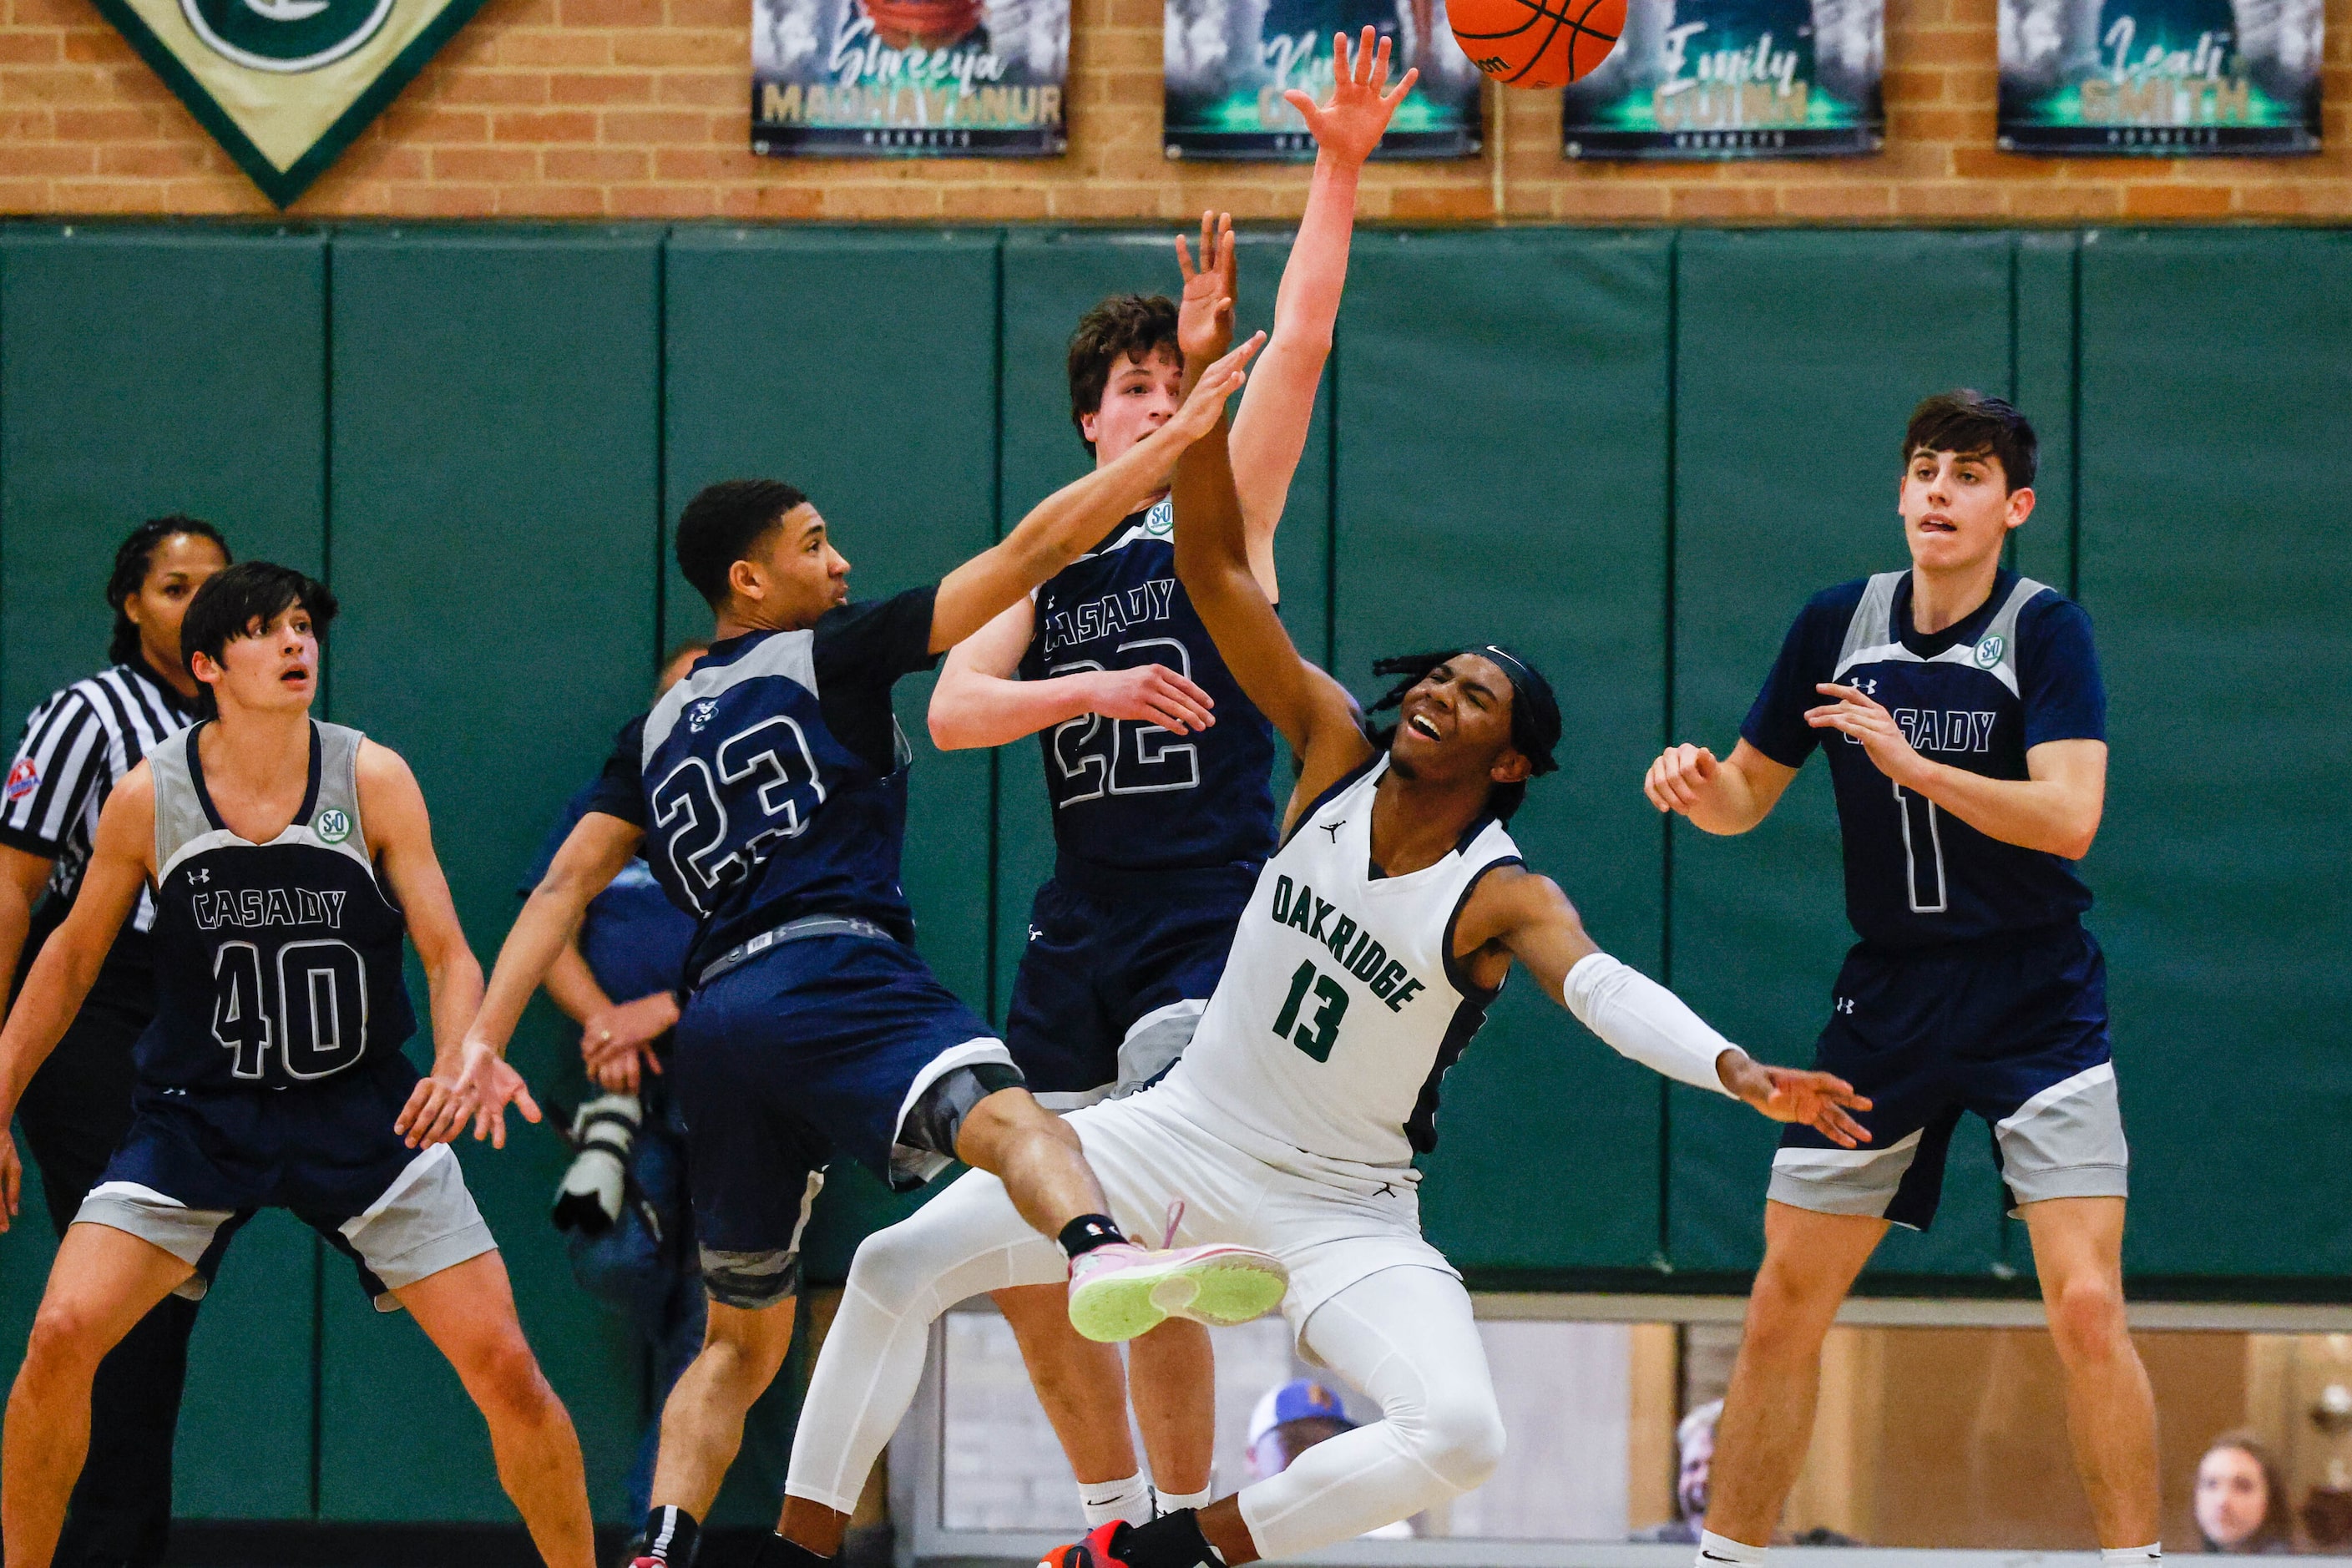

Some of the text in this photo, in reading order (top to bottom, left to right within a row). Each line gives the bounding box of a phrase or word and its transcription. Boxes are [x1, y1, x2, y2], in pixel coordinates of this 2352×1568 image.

[1659, 22, 1798, 98] Emily
[2081, 78, 2248, 123] SMITH
[1844, 707, 1997, 752] SADY
[652, 714, 827, 919] 23
[1892, 776, 1948, 913] 1
[192, 887, 347, 930] CASADY
[1271, 873, 1427, 1014] OAKRIDGE
[211, 938, 369, 1080] 40
[1271, 958, 1350, 1064] 13
